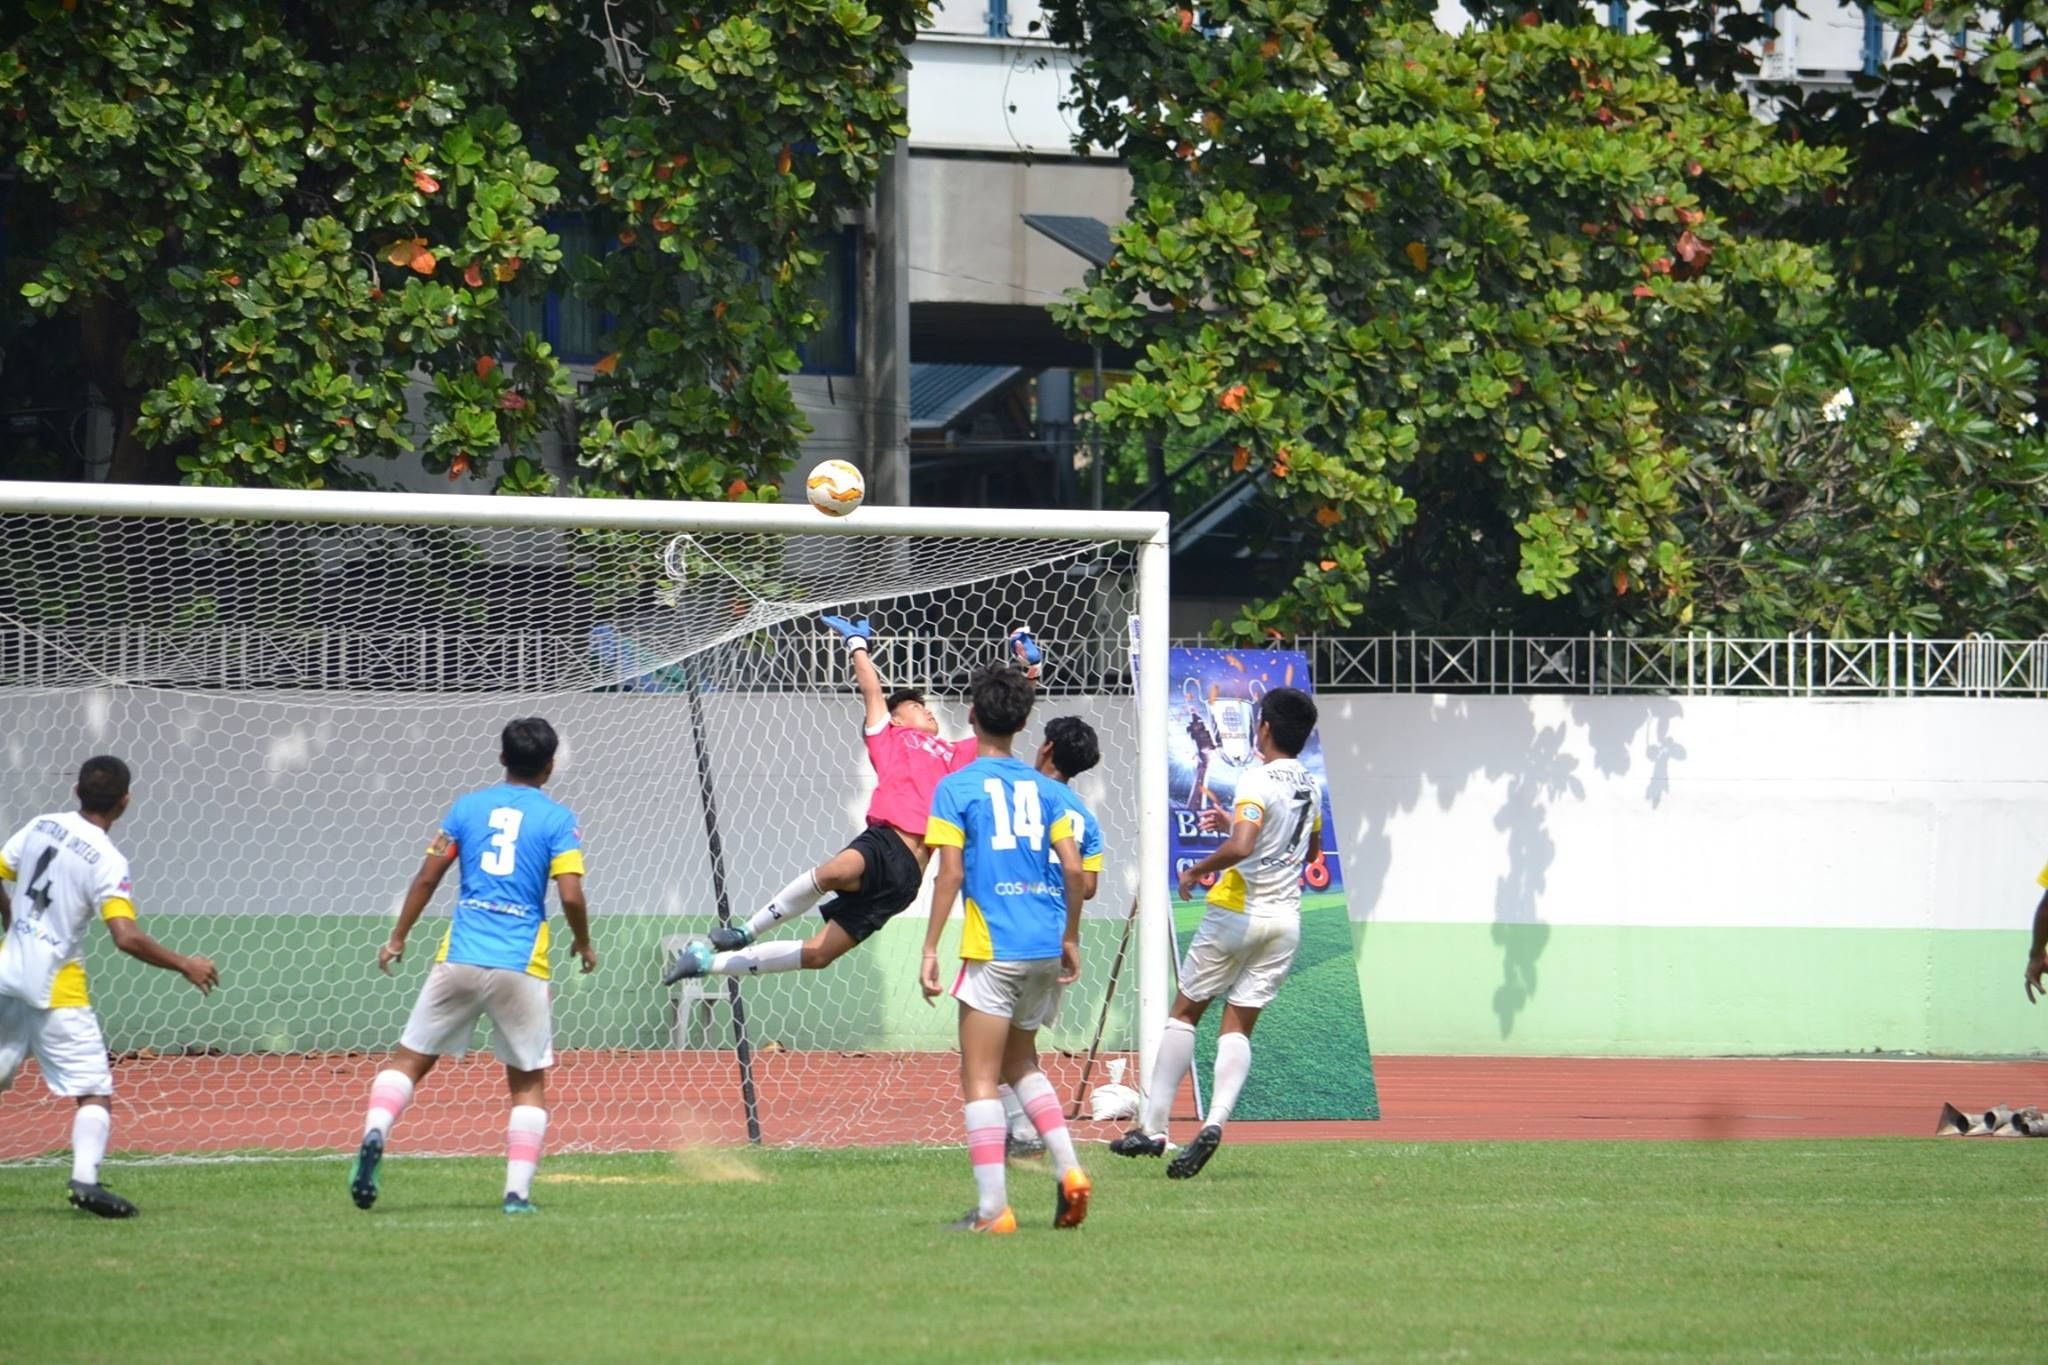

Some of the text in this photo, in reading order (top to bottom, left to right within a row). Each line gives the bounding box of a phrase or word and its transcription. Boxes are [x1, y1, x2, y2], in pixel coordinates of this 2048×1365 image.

[480, 806, 524, 876] 3
[984, 778, 1045, 851] 14
[1286, 789, 1312, 854] 7
[24, 845, 59, 920] 4
